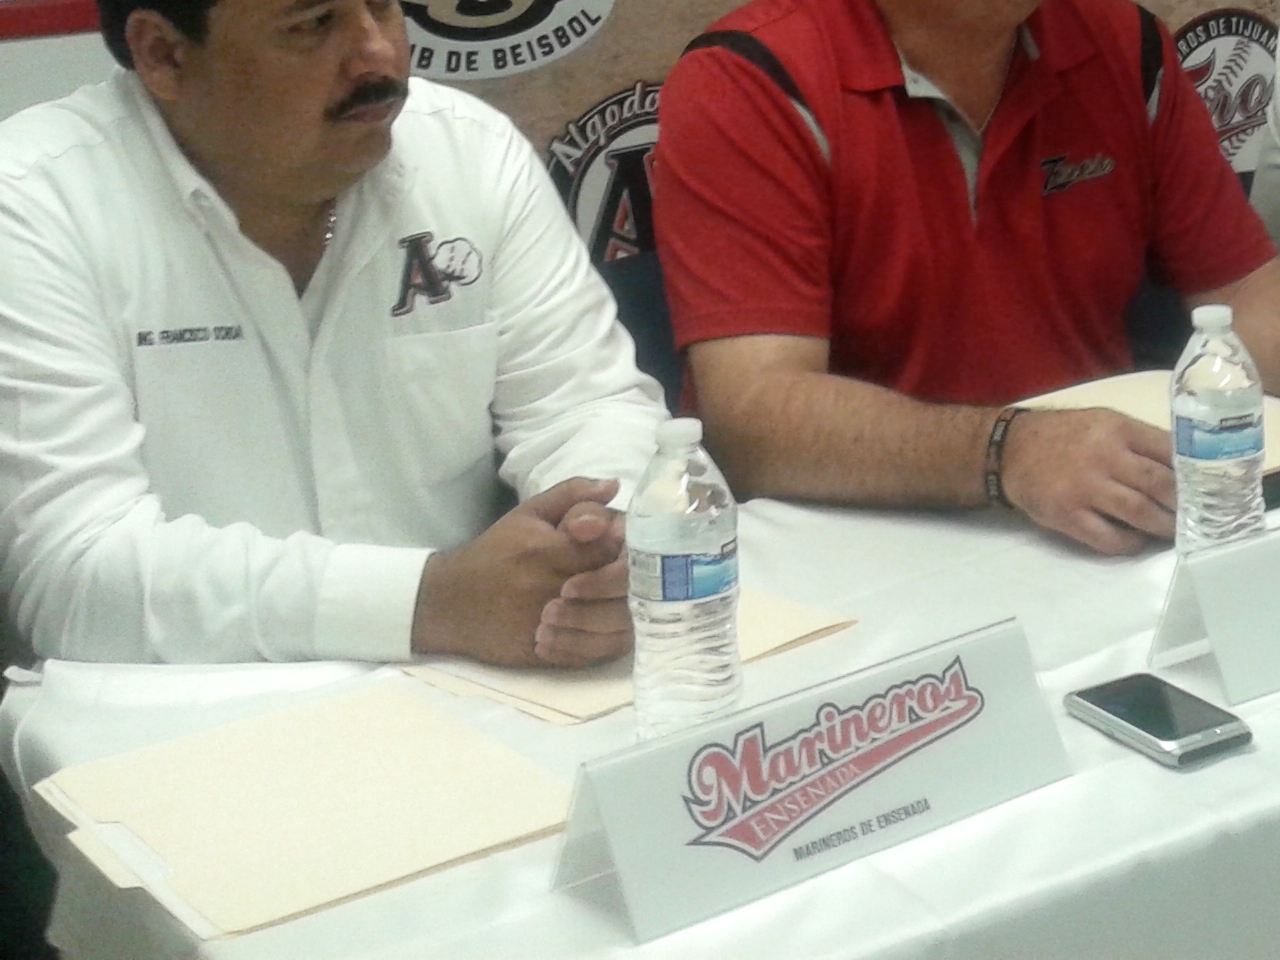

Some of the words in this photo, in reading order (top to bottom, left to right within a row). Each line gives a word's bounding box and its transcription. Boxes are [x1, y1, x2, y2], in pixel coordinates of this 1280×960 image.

[445, 50, 480, 74] DE
[492, 8, 603, 71] BEISBOL
[1176, 24, 1207, 57] ROS
[1208, 18, 1226, 37] DE
[1230, 16, 1278, 52] TIJUAN
[684, 656, 985, 827] Marineros
[792, 825, 860, 861] MARINEROS
[859, 818, 882, 837] DE
[875, 798, 932, 830] ENSENADA
